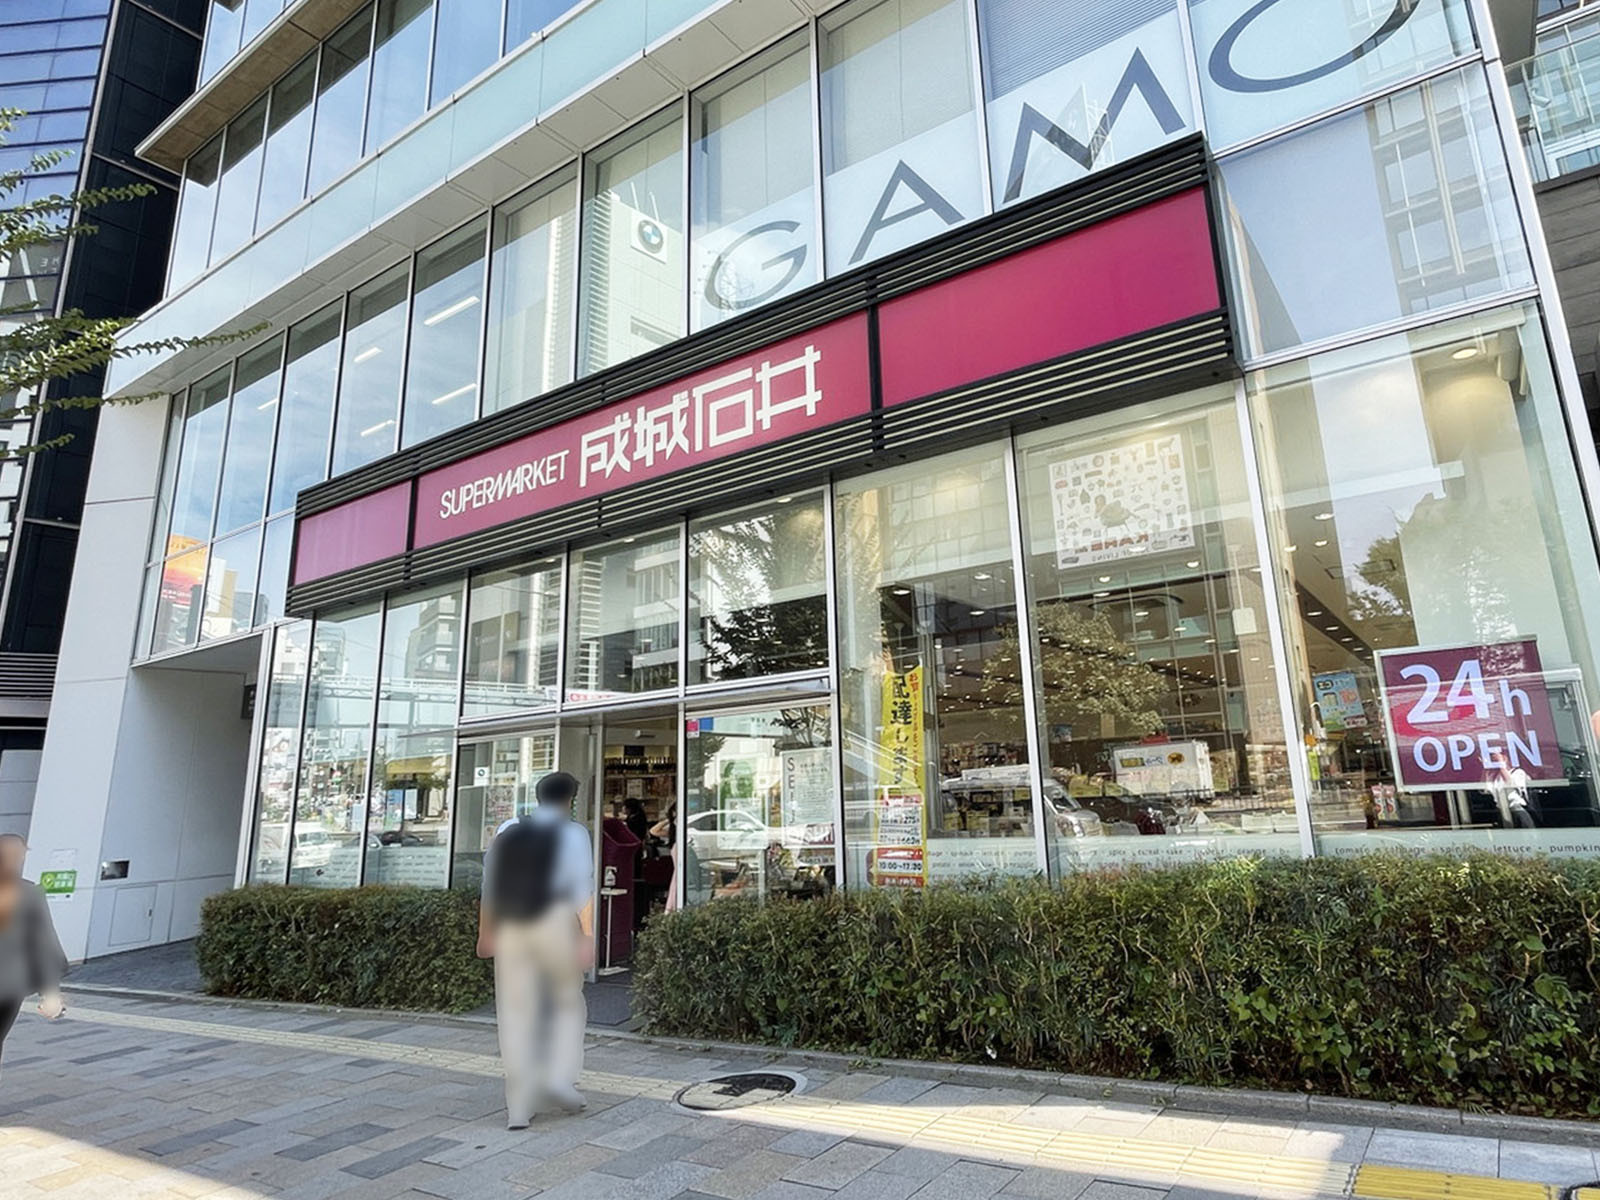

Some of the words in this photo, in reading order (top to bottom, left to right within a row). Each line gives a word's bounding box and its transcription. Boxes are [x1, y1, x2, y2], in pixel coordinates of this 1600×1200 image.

[579, 345, 822, 487] 成城石井
[440, 449, 570, 519] SUPERMARKET
[1400, 659, 1532, 723] 24h
[1413, 731, 1542, 772] OPEN
[1493, 845, 1532, 853] lettuce
